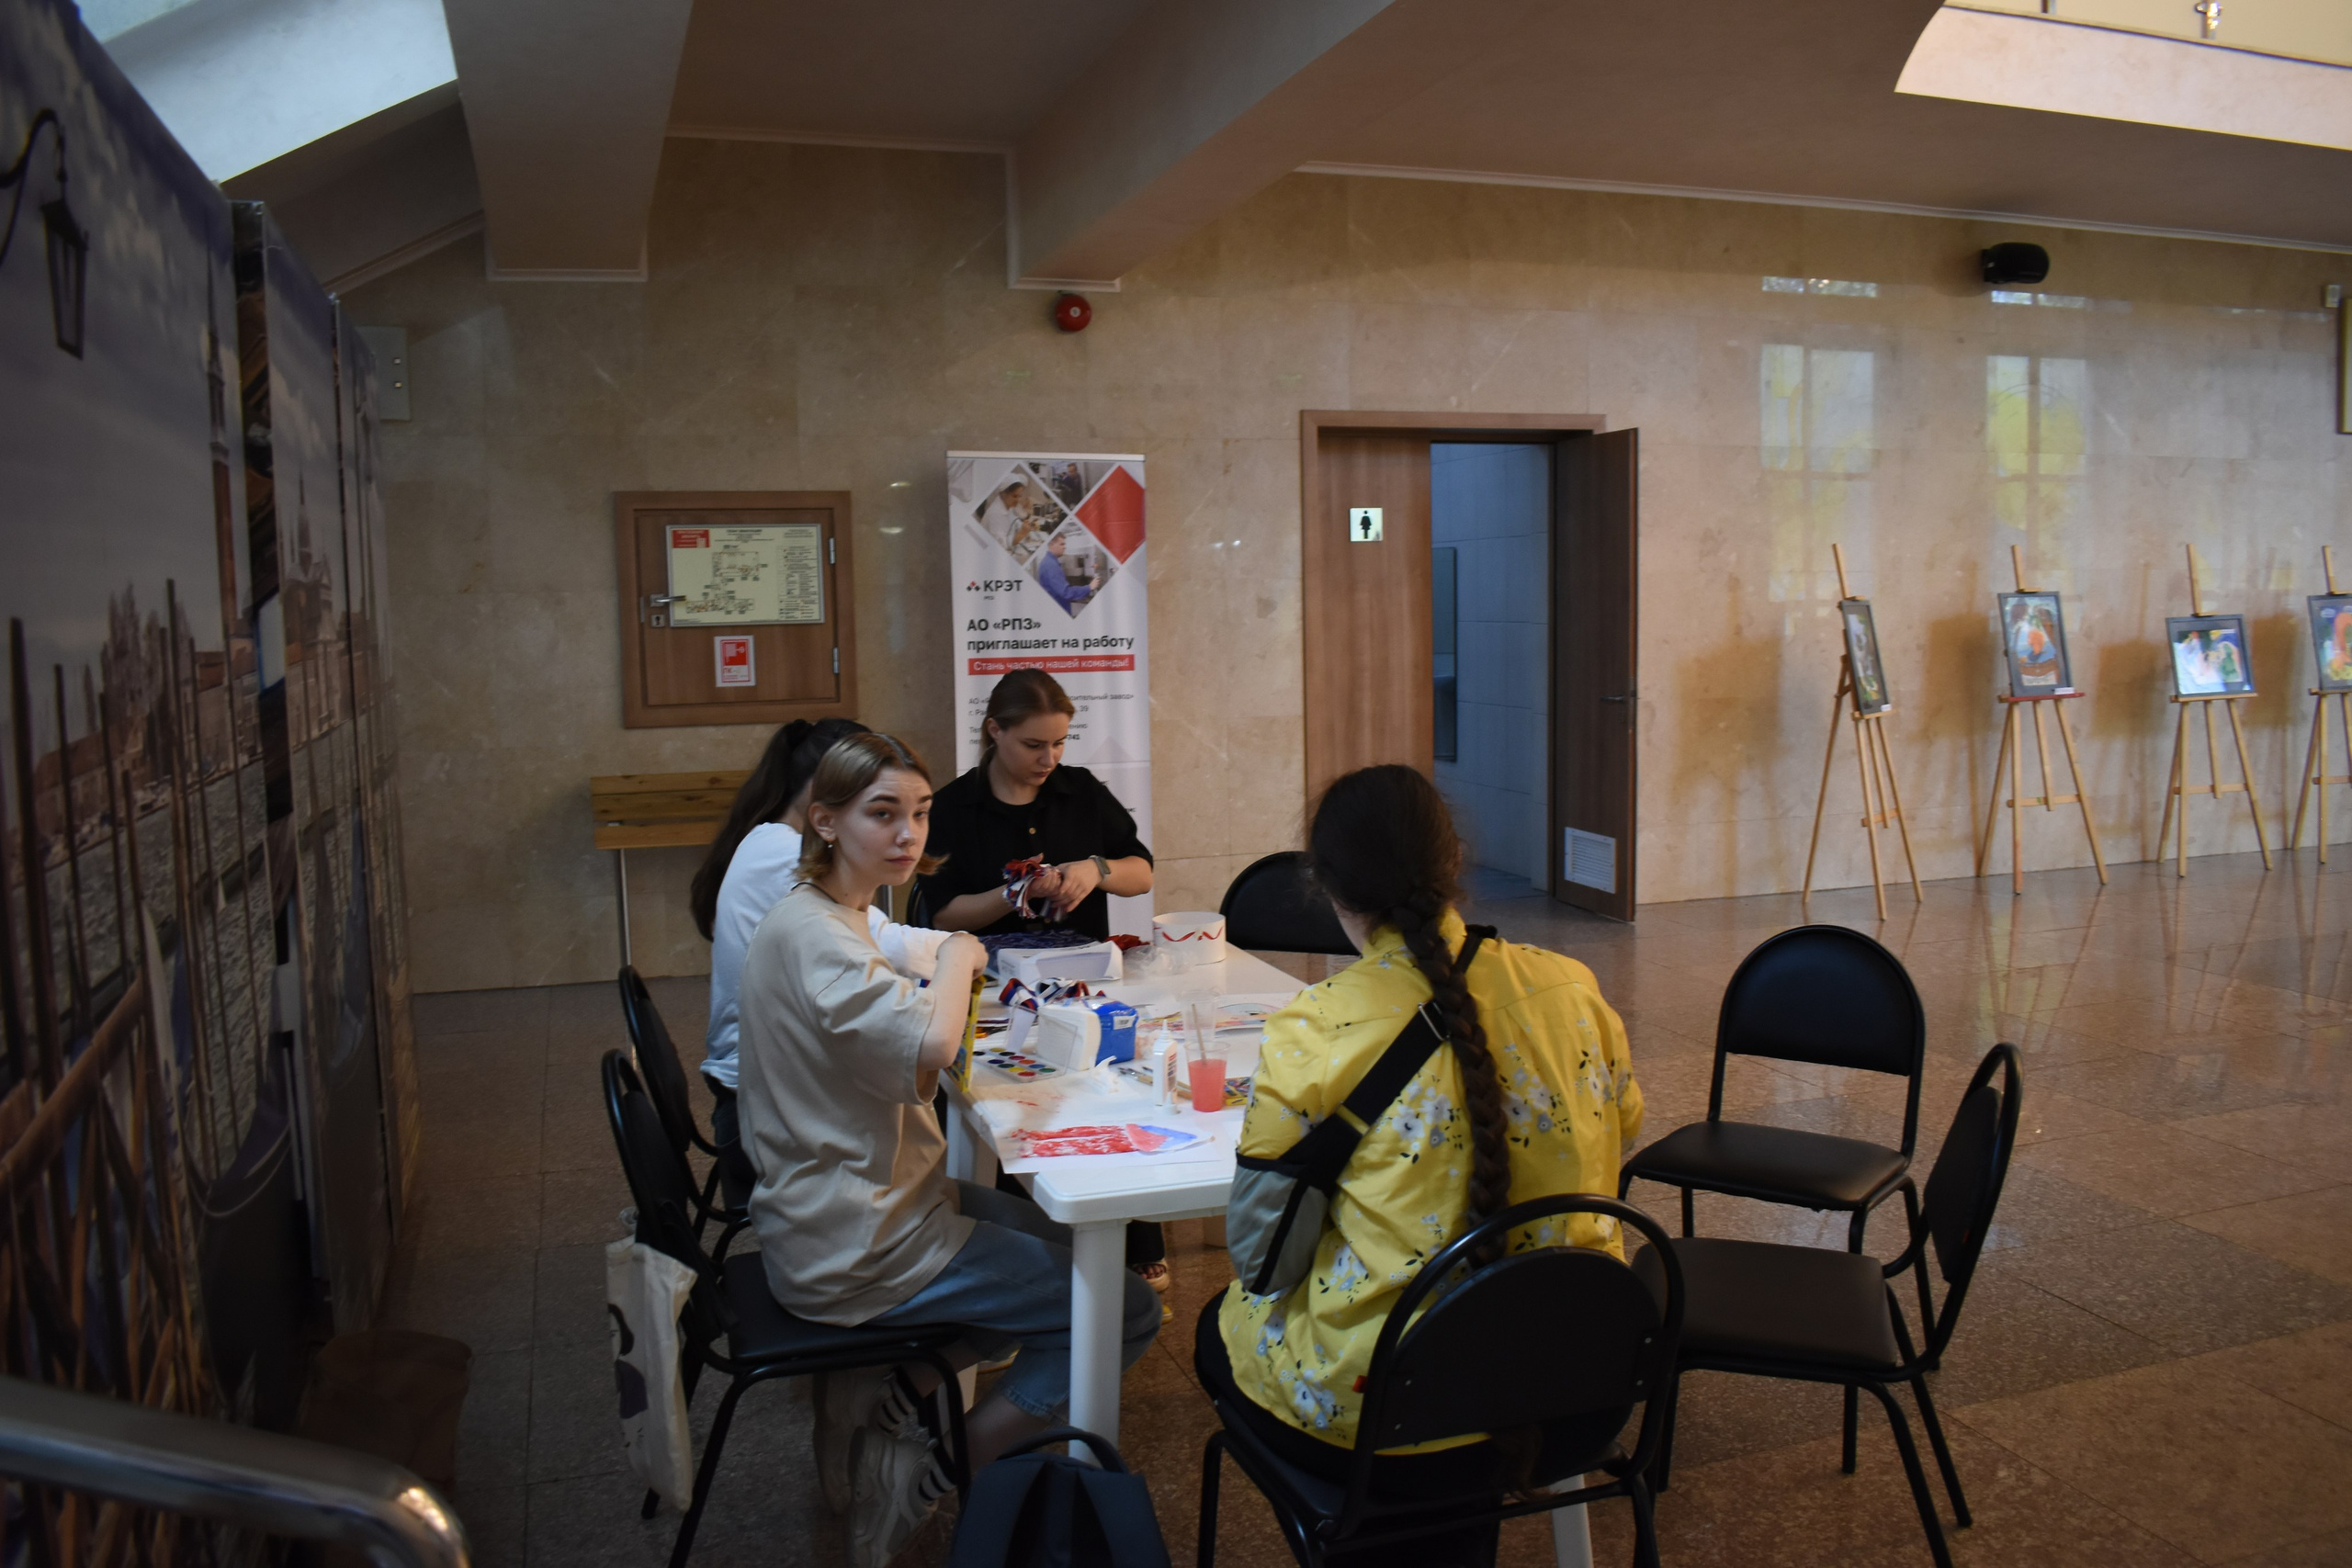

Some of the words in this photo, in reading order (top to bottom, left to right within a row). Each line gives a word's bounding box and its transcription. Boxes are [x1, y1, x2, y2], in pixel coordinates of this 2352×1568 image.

[983, 580, 1023, 592] КРЭТ
[967, 619, 989, 632] АО
[993, 617, 1042, 631] «РПЗ»
[967, 638, 1057, 653] приглашает
[1061, 637, 1080, 649] на
[1083, 635, 1135, 651] работу
[973, 660, 1005, 671] Стань
[1007, 660, 1045, 671] частью
[1046, 659, 1080, 669] нашей
[1080, 657, 1129, 669] команды!
